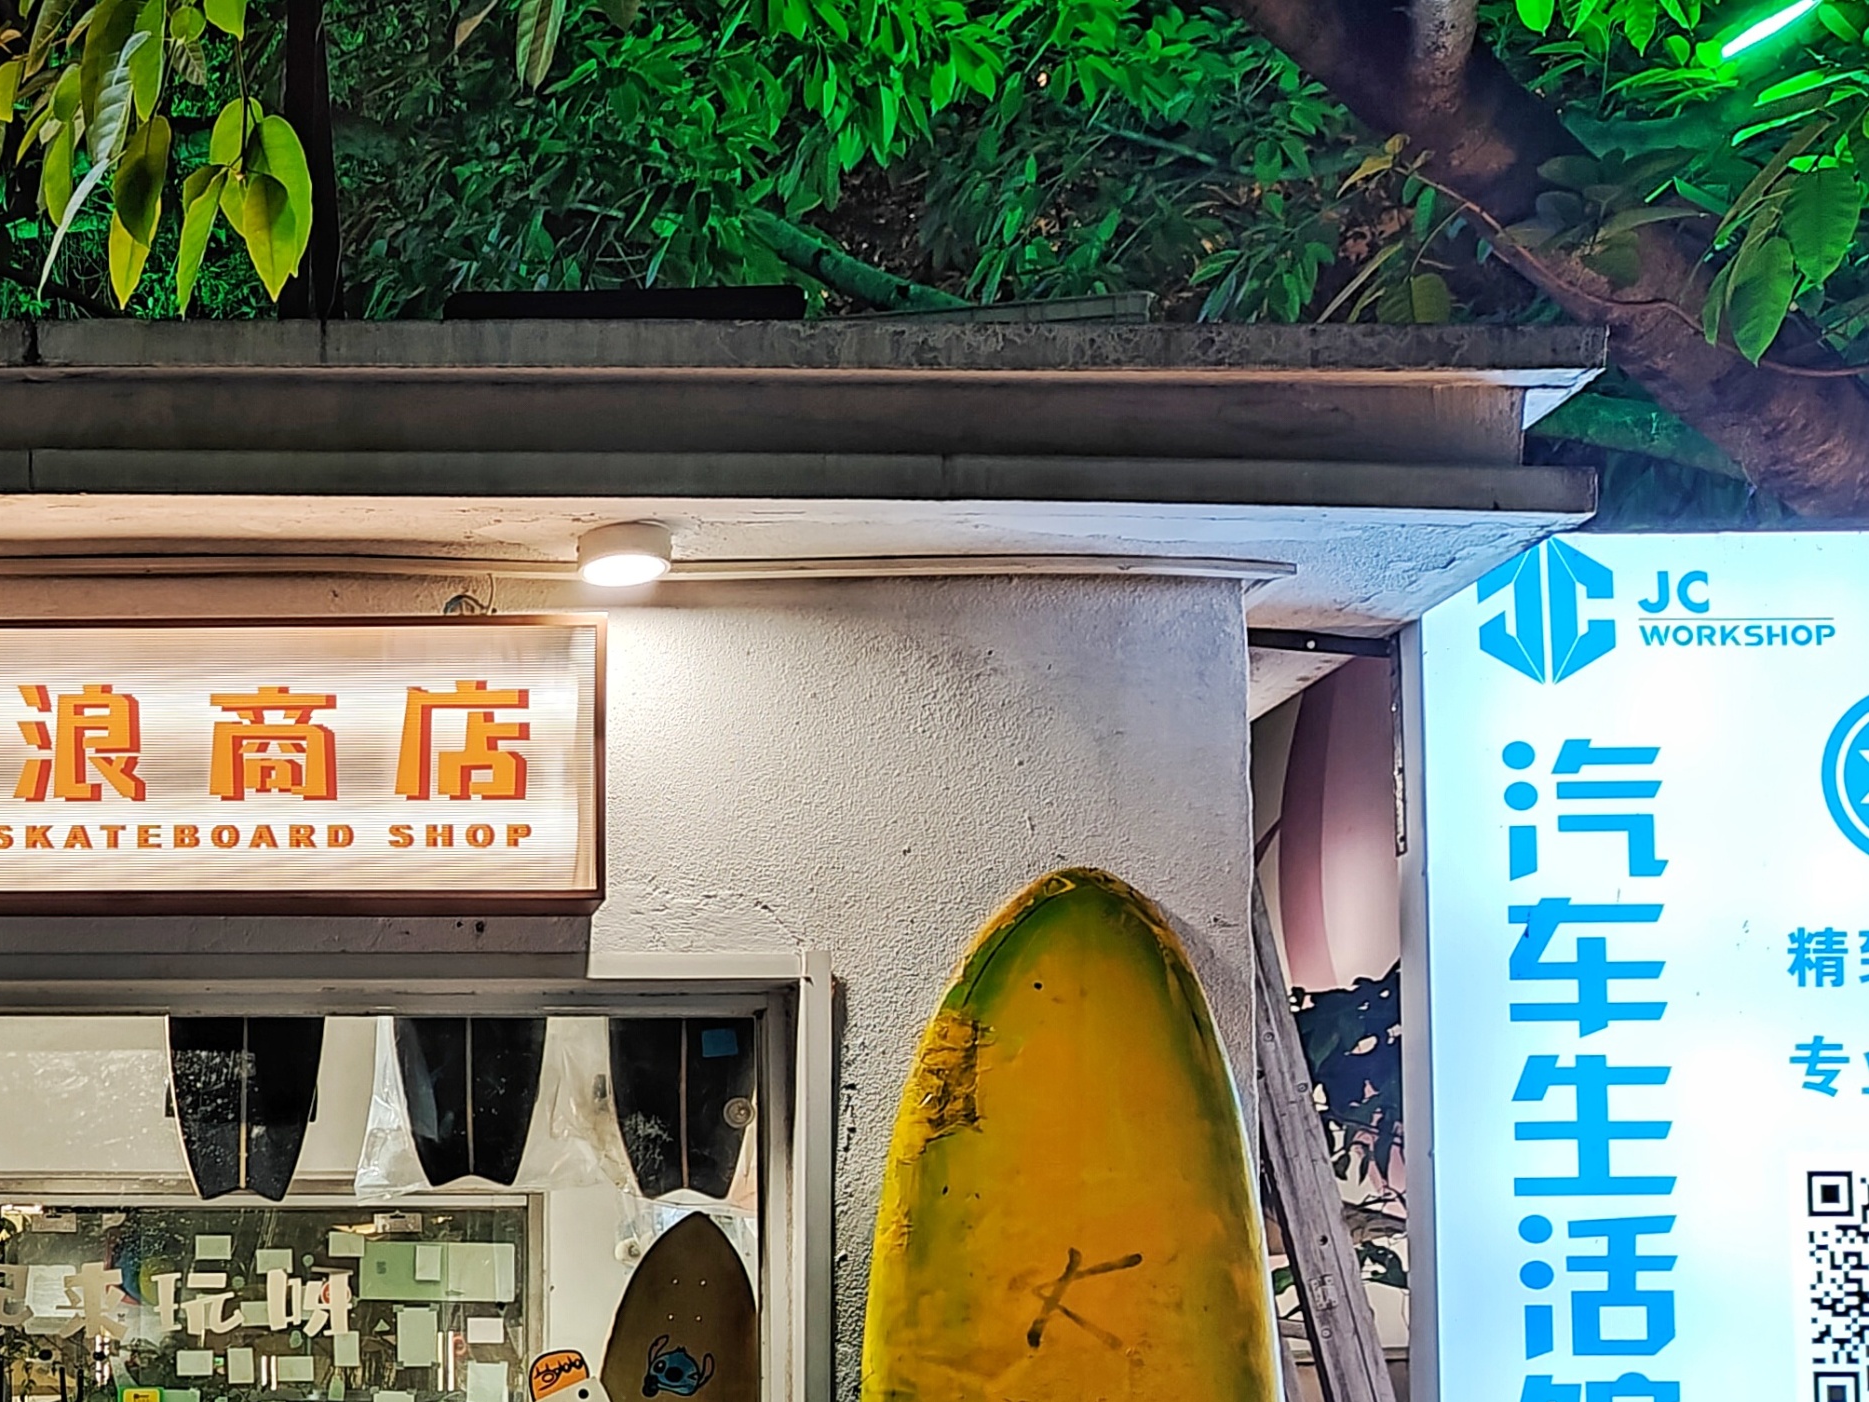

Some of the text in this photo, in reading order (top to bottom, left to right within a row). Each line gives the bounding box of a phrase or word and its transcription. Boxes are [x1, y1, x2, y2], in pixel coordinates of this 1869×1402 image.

[1638, 571, 1710, 613] JC
[1639, 625, 1835, 647] WORKSHOP
[388, 823, 535, 849] SHOP
[1787, 927, 1869, 987] 精
[1789, 1035, 1869, 1097] 专
